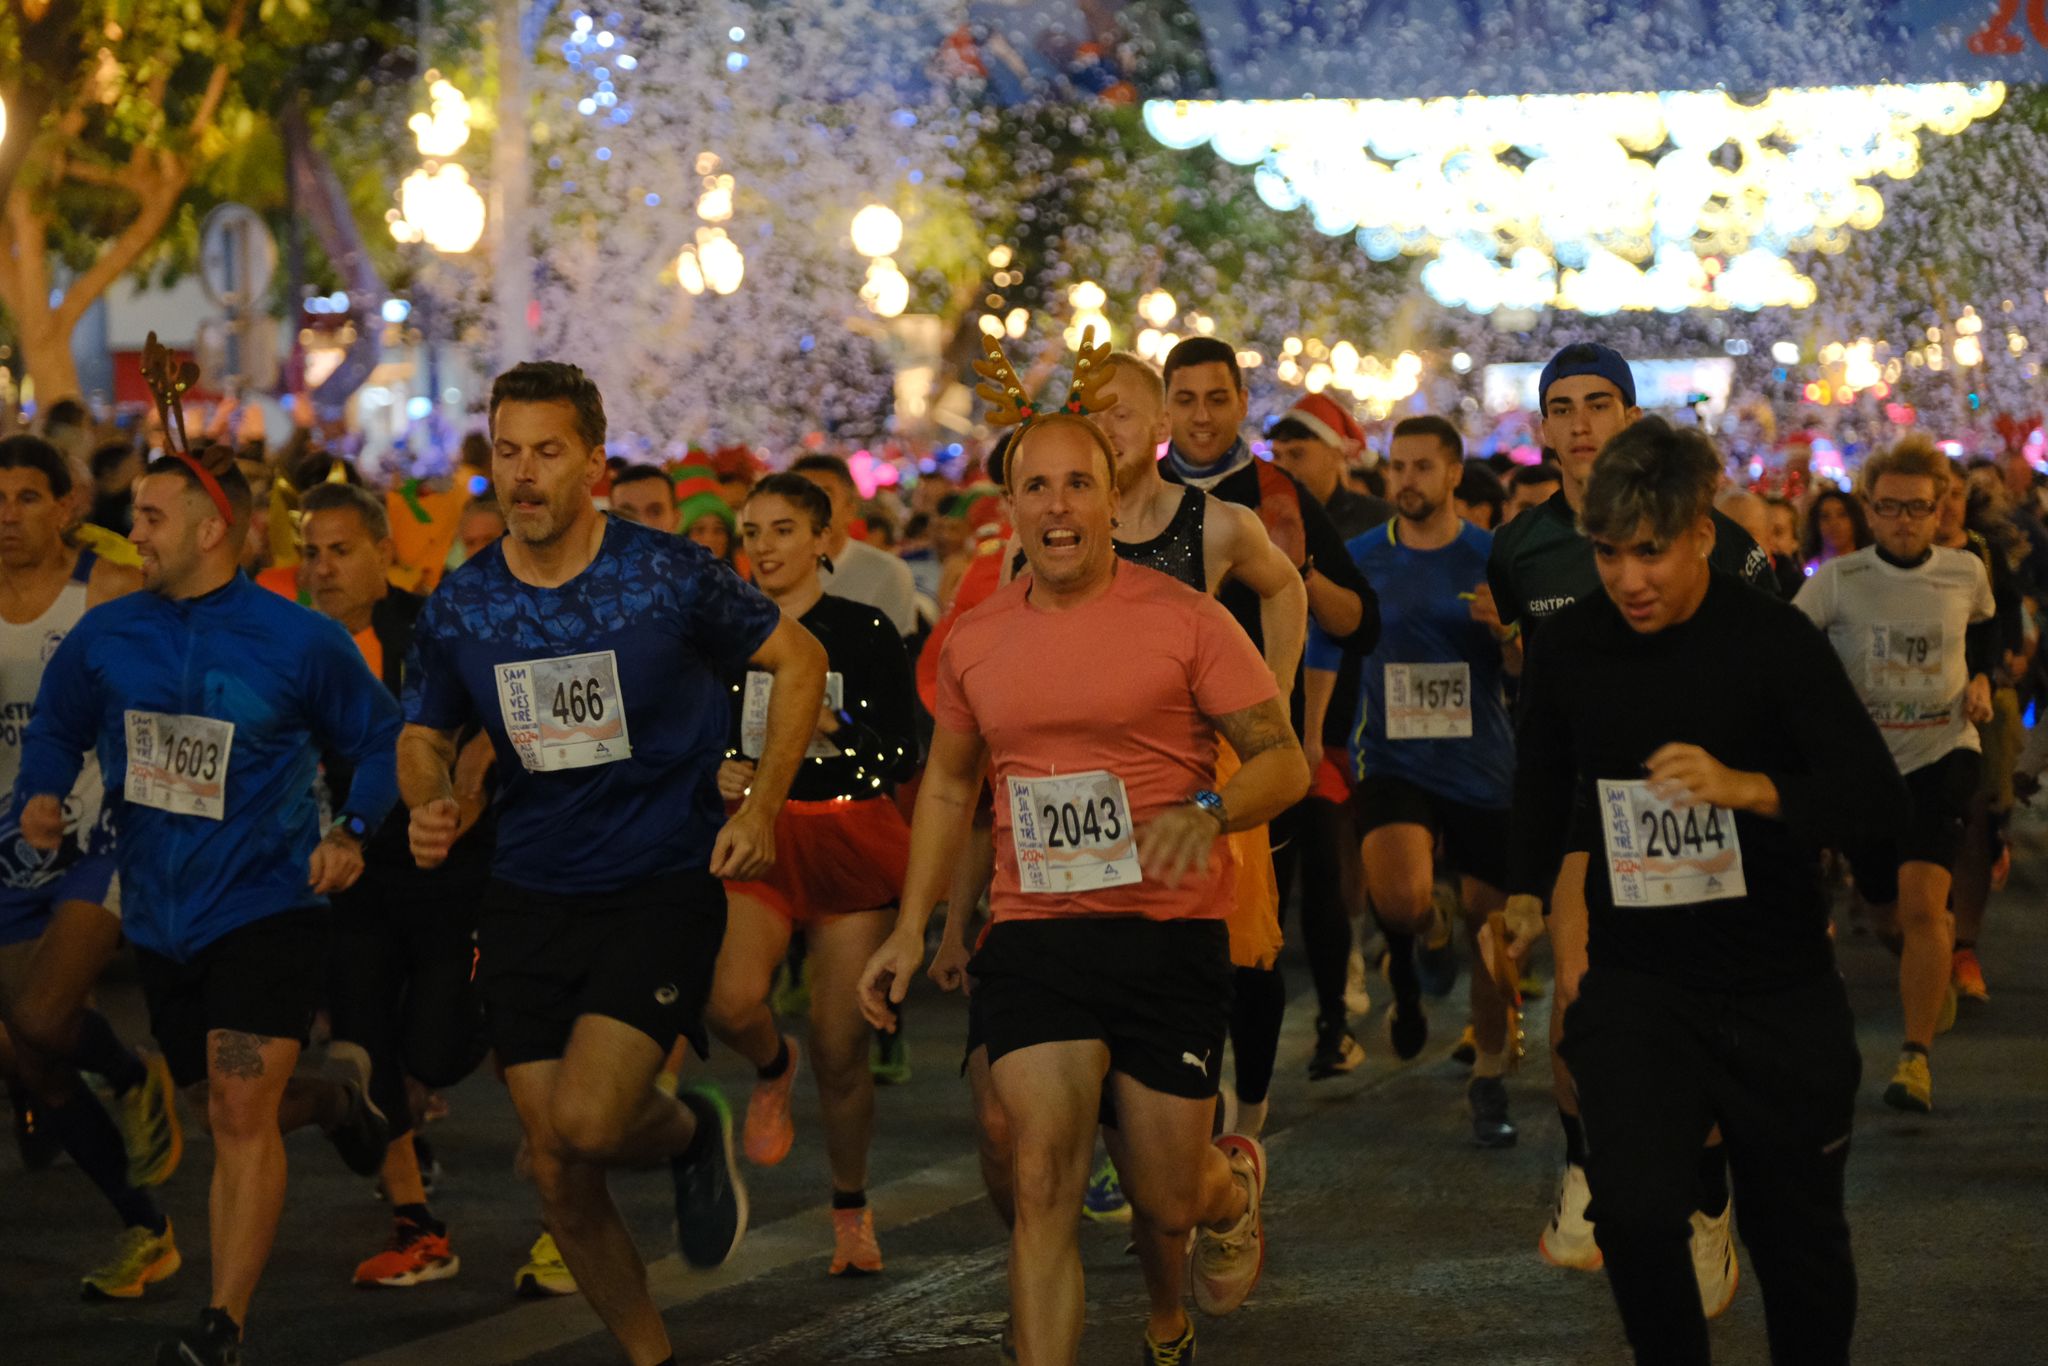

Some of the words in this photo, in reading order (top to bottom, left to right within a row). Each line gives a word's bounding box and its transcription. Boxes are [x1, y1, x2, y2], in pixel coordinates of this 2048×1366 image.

[1905, 637, 1928, 664] 79
[503, 668, 527, 683] SAN
[552, 677, 604, 725] 466
[1413, 679, 1465, 709] 1575
[509, 695, 529, 709] VES
[511, 708, 532, 723] TRE
[511, 731, 539, 745] 2024
[164, 734, 219, 782] 1603
[1013, 783, 1029, 796] SAN
[1018, 812, 1034, 829] VES
[1043, 796, 1121, 848] 2043
[1612, 819, 1630, 834] VES
[1020, 828, 1037, 841] TRE
[1641, 804, 1725, 858] 2044
[1613, 834, 1632, 850] TRE
[1021, 850, 1044, 861] 2024
[1613, 859, 1641, 873] 2024
